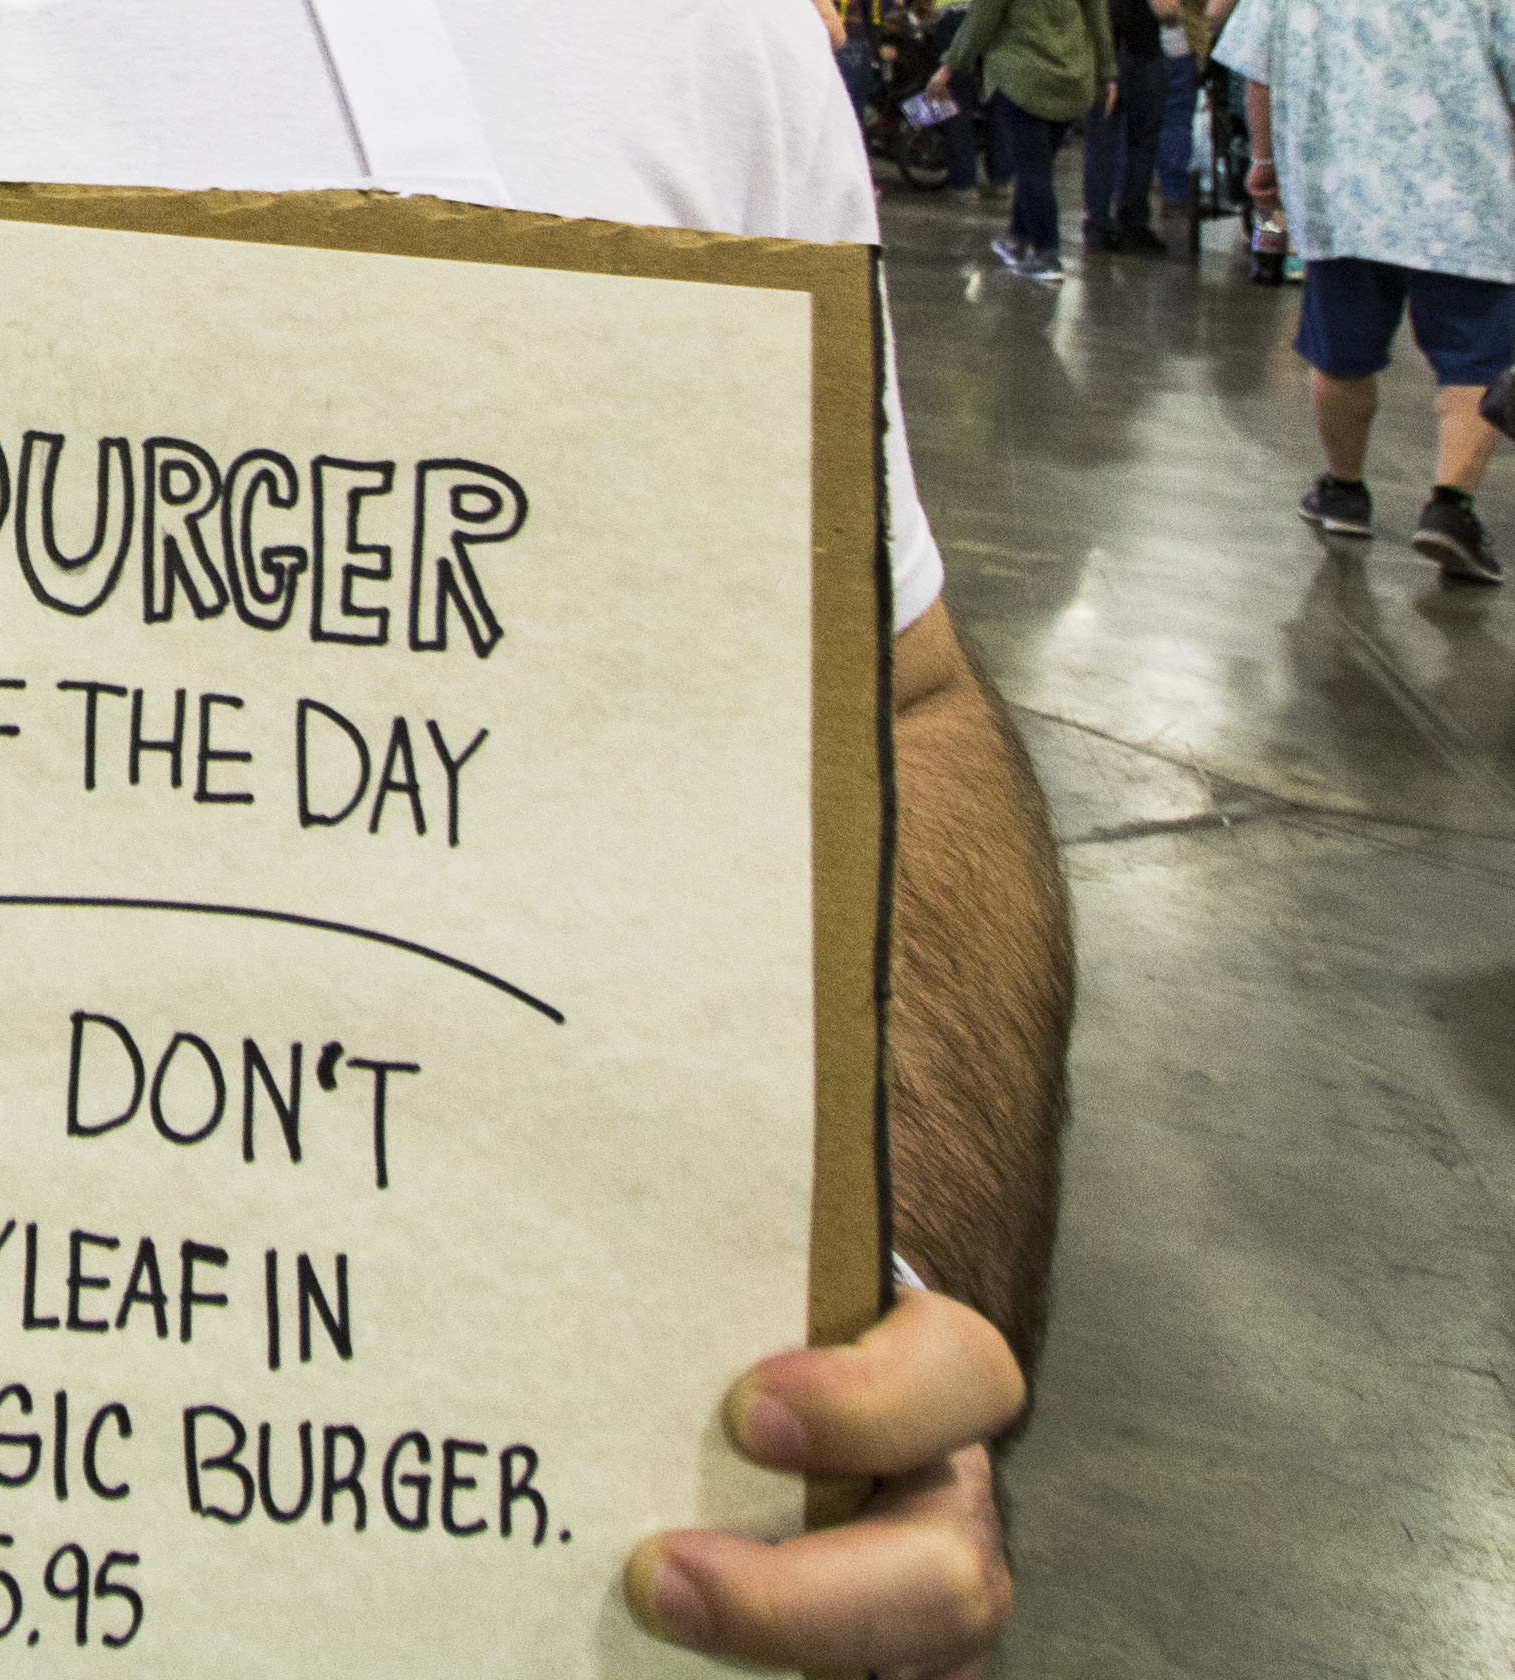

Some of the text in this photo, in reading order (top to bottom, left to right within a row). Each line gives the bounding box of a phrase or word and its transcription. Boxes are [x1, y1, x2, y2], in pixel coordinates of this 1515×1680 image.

[56, 680, 255, 805] THE
[296, 698, 489, 847] DAY
[66, 1010, 421, 1189] DON'T
[265, 1249, 353, 1371] IN
[182, 1404, 572, 1546] BURGER.
